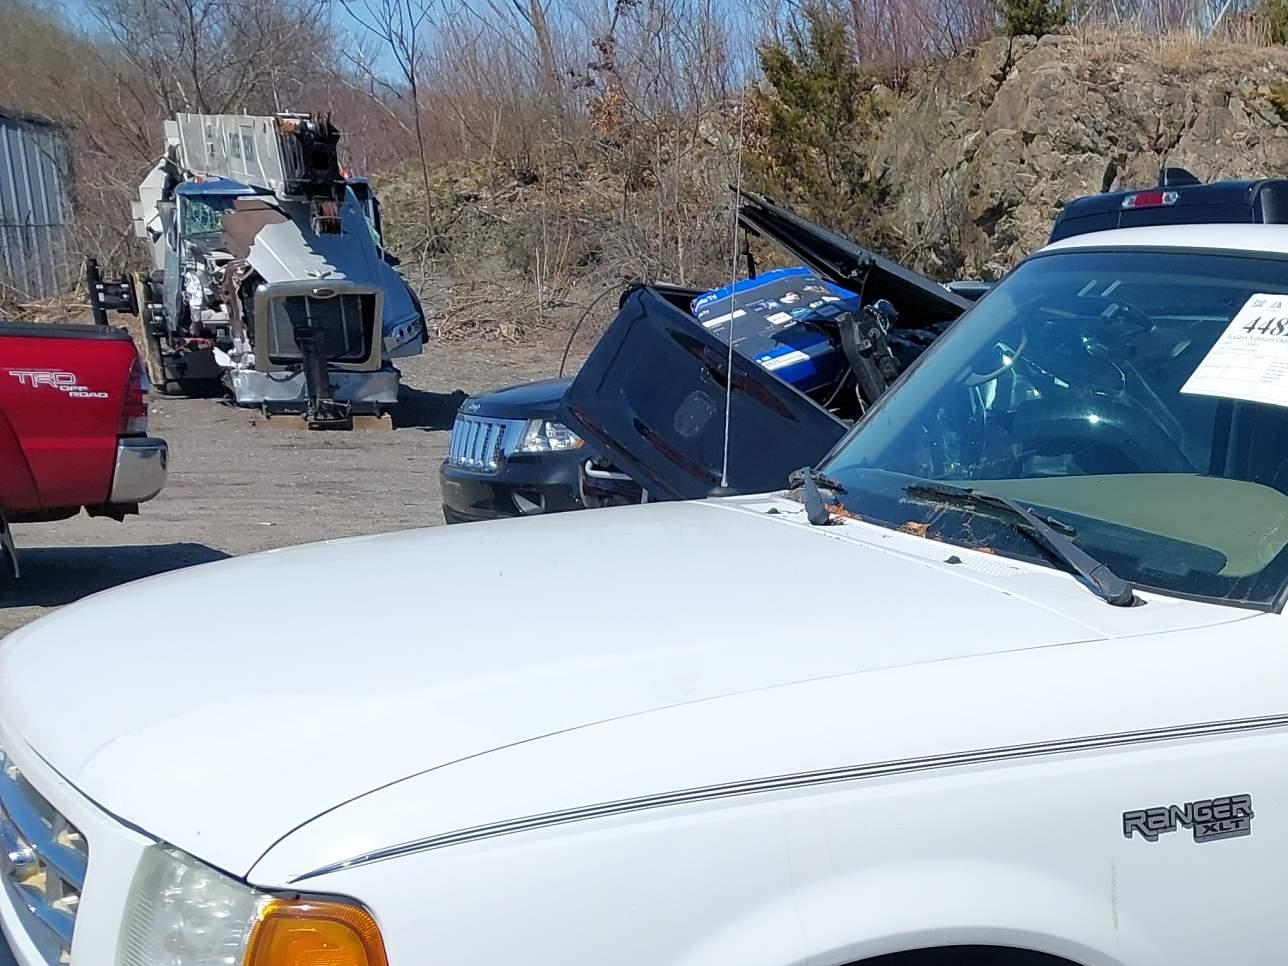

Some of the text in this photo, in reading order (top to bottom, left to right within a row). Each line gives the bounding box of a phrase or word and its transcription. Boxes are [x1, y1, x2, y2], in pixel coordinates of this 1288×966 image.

[9, 370, 76, 388] TRD
[1123, 794, 1254, 842] RANGER
[1202, 818, 1245, 835] XLT
